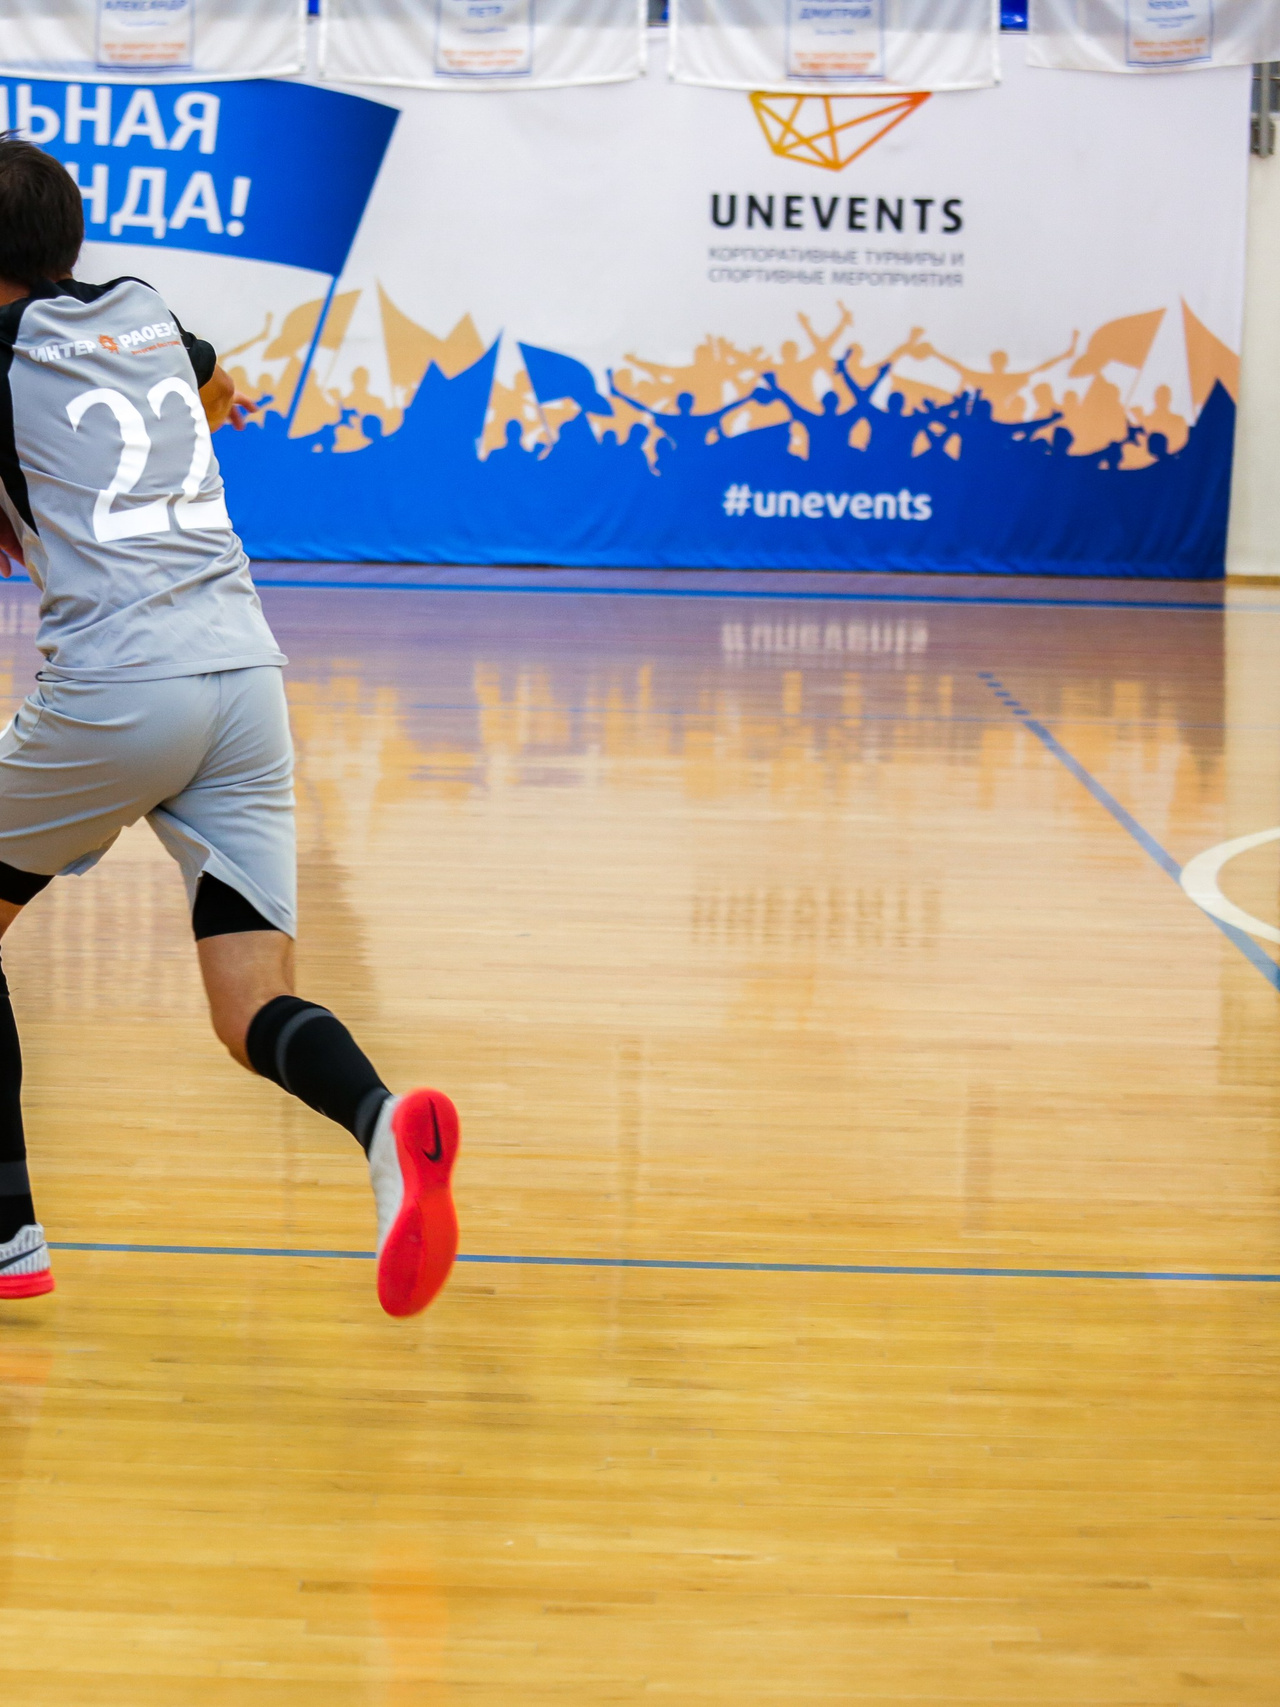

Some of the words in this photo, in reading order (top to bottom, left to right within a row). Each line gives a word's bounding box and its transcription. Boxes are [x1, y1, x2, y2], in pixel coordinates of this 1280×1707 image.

[710, 194, 963, 234] UNEVENTS
[708, 248, 858, 265] КОРПОРАТИВНЫЕ
[865, 251, 945, 266] ТУРНИРЫ
[950, 252, 964, 266] И
[708, 268, 824, 285] СПОРТИВНЫЕ
[831, 270, 964, 287] МЕРОПРИЯТИЯ
[29, 339, 97, 362] ИНТЕР
[65, 377, 233, 543] 22
[723, 483, 933, 521] #unevents
